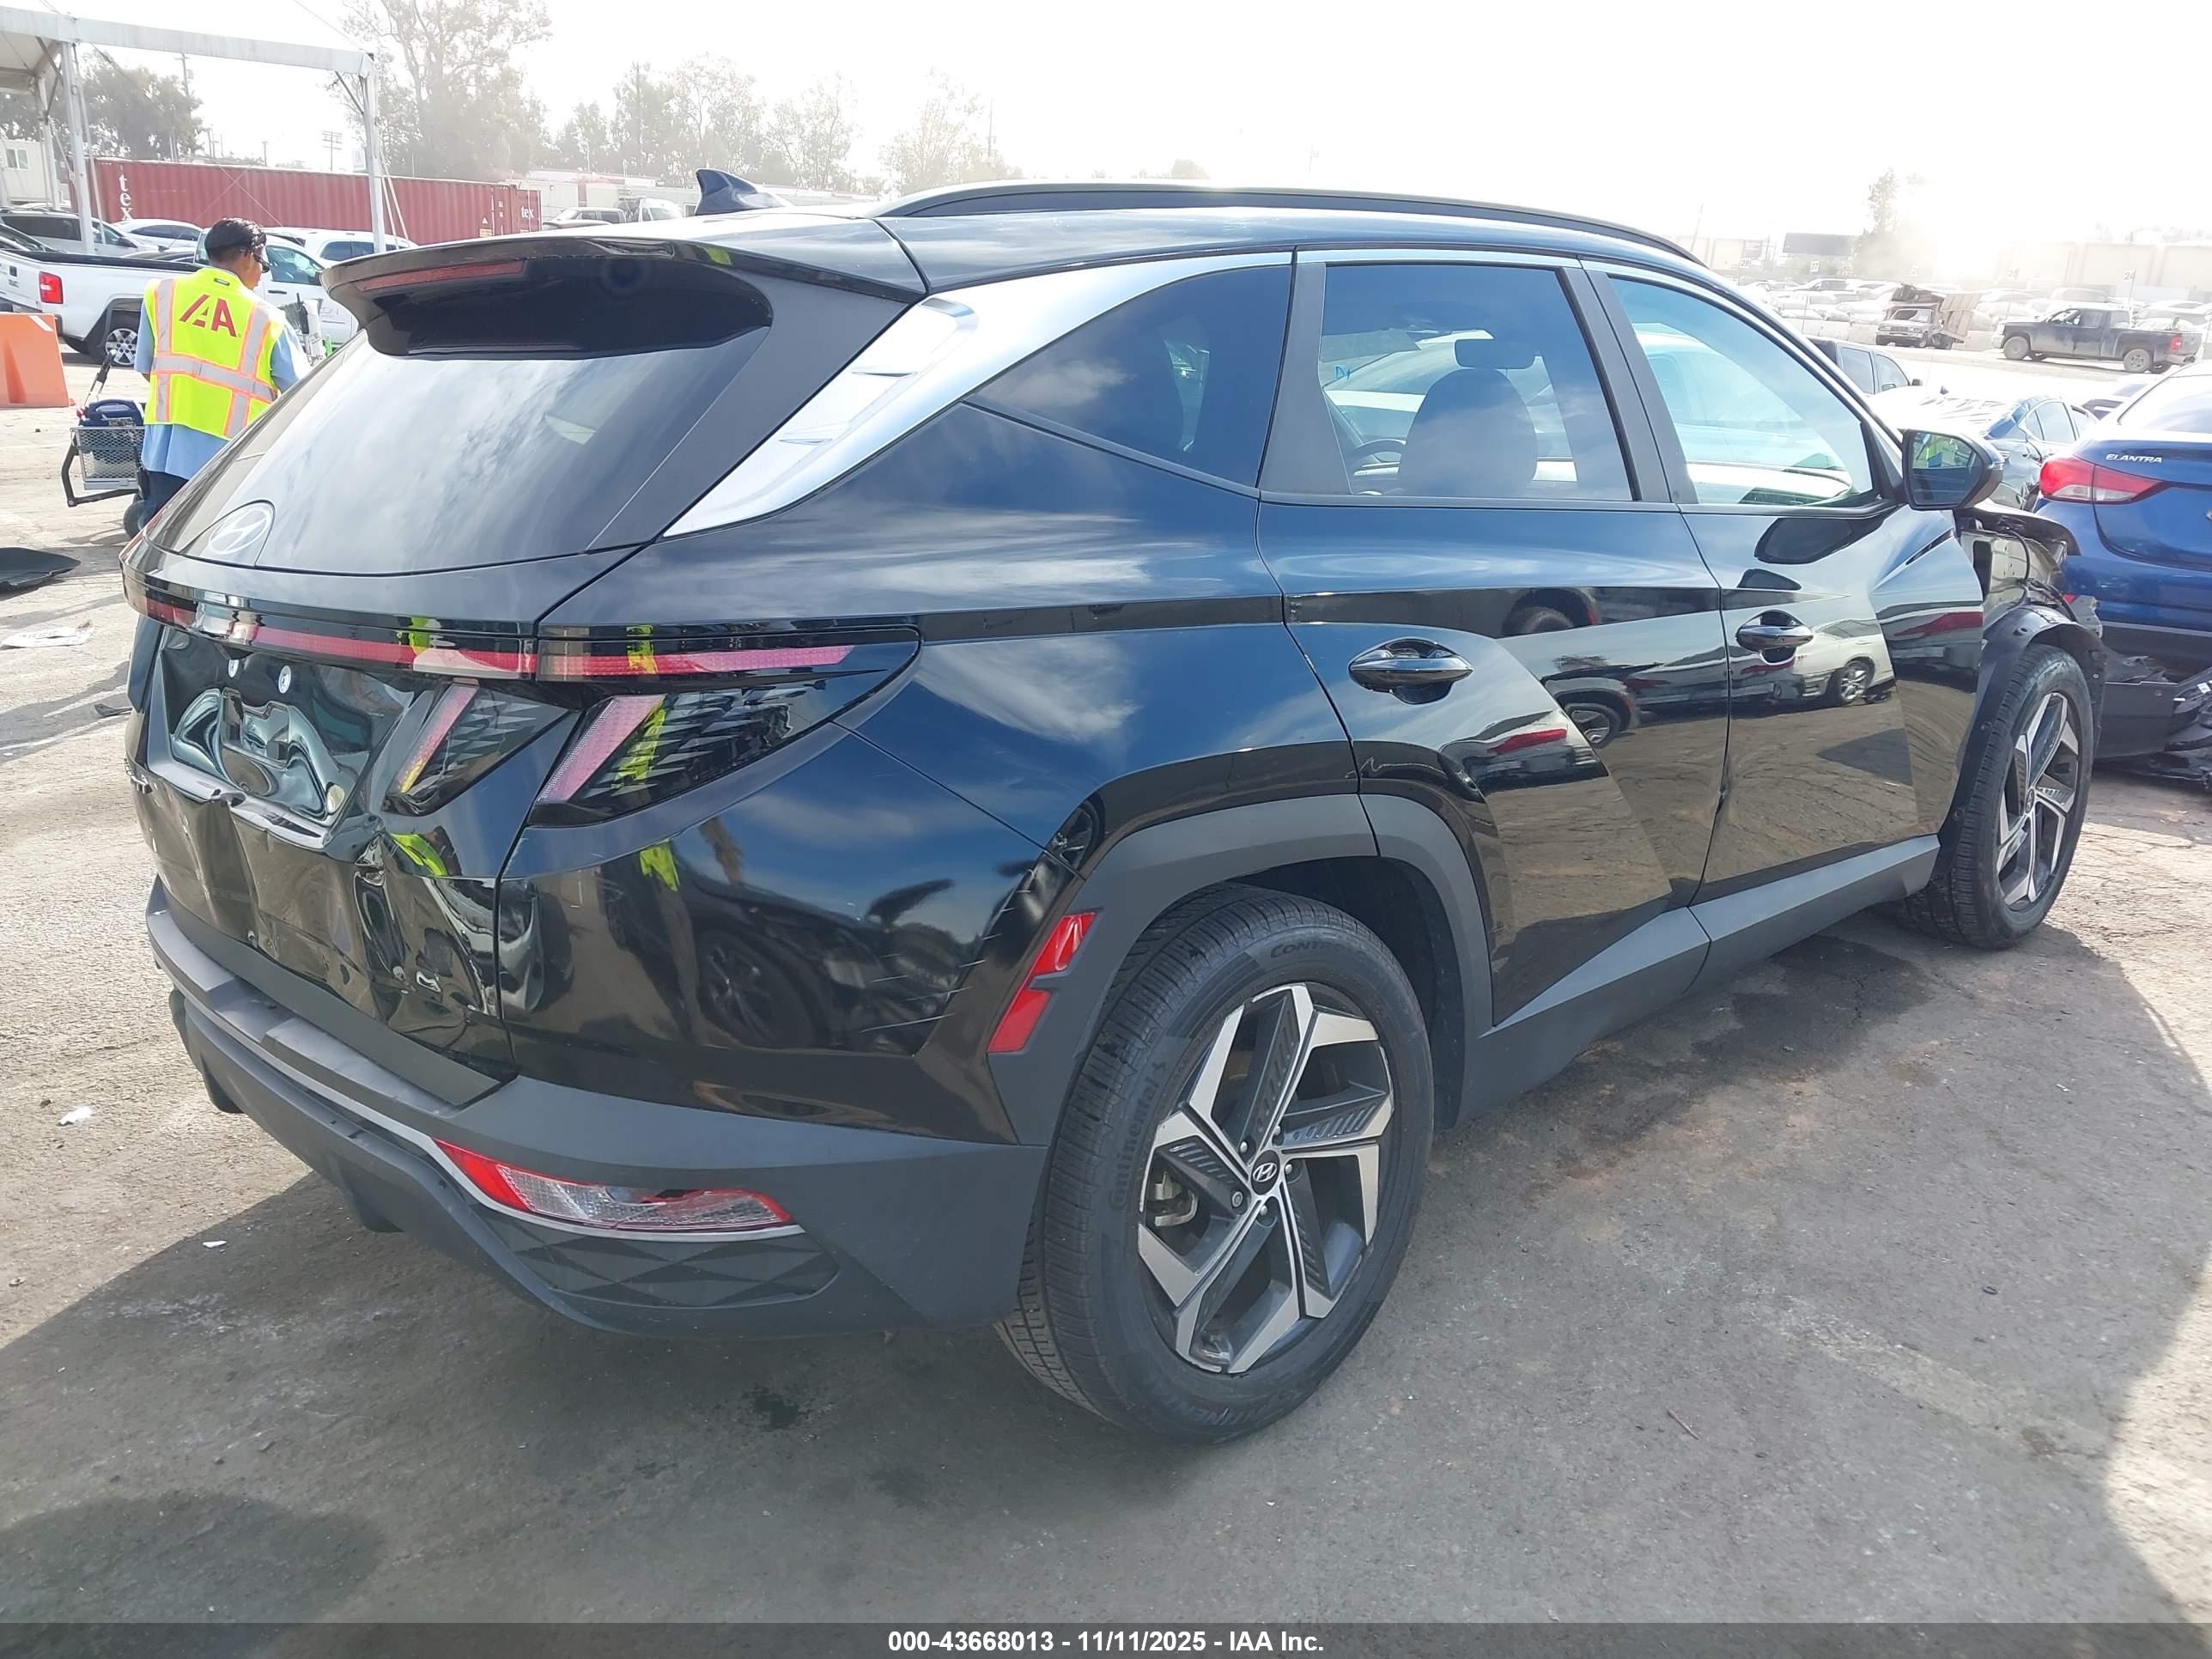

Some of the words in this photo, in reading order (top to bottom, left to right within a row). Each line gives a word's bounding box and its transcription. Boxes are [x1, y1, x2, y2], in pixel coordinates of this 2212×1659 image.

[118, 173, 134, 220] tex
[520, 206, 534, 218] tex
[2106, 453, 2162, 464] ELANTRA
